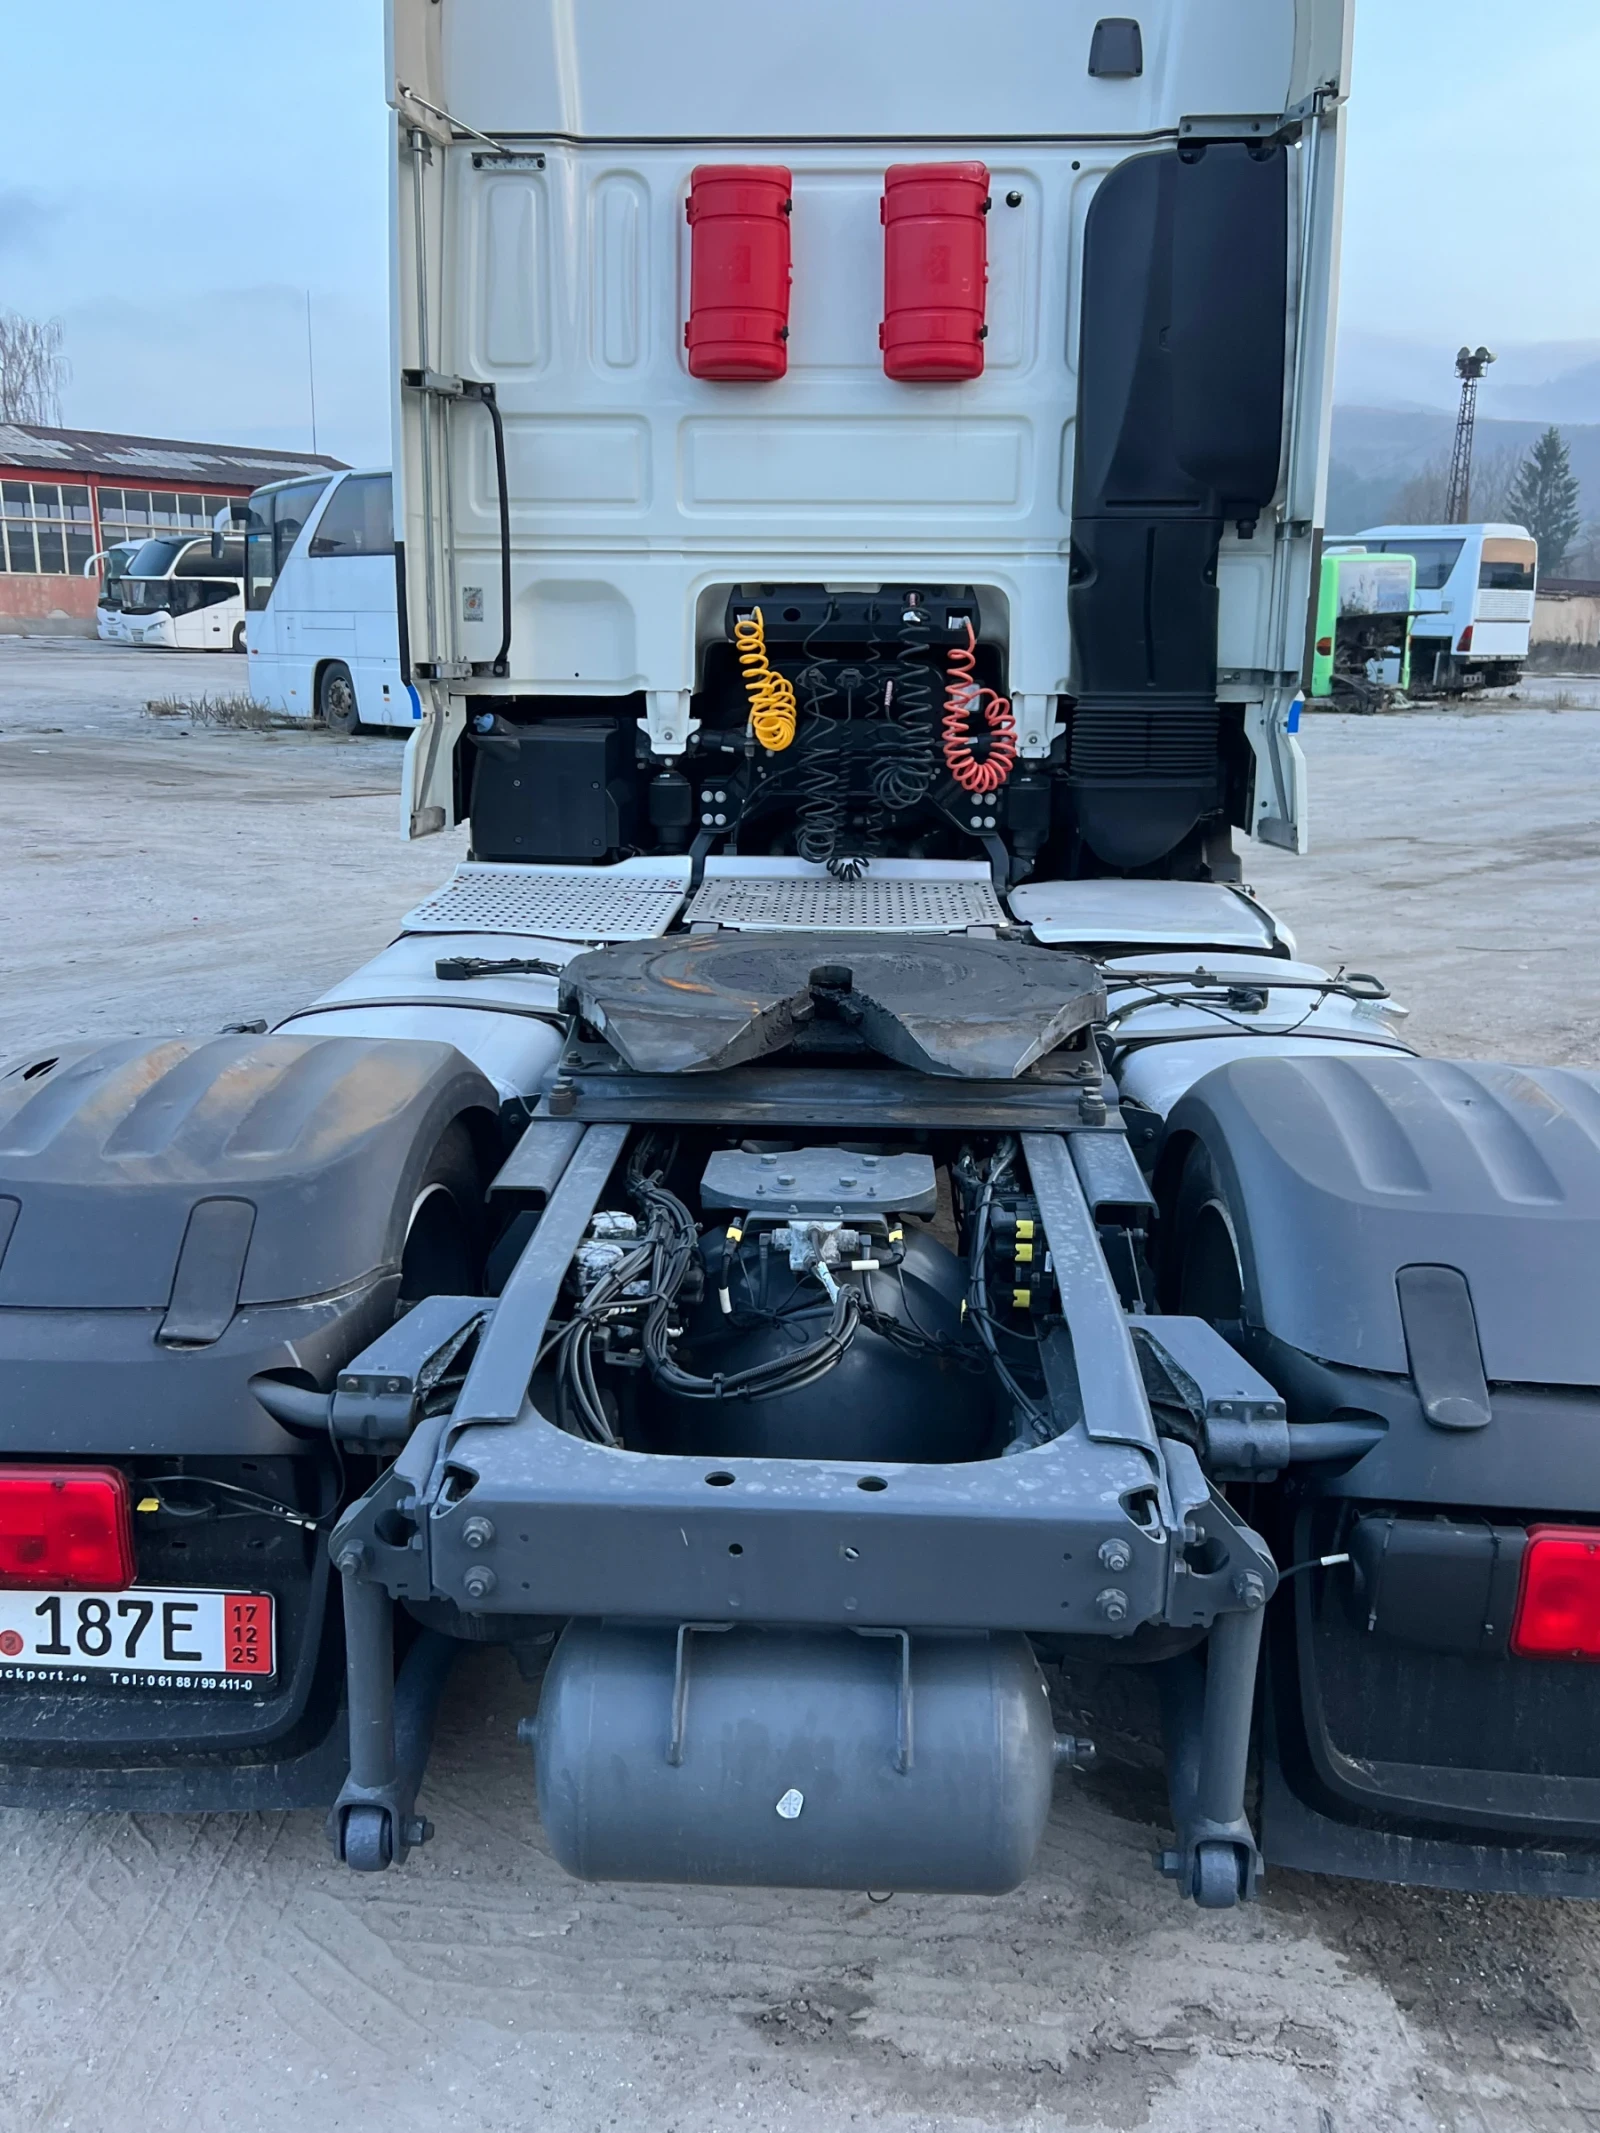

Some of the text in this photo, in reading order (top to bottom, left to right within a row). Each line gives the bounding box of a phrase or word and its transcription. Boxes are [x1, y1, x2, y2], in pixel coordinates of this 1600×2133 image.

[232, 1604, 258, 1623] 17
[35, 1596, 202, 1662] 187E
[232, 1624, 258, 1643] 12
[232, 1645, 259, 1664] 25
[219, 1678, 253, 1690] 411-0
